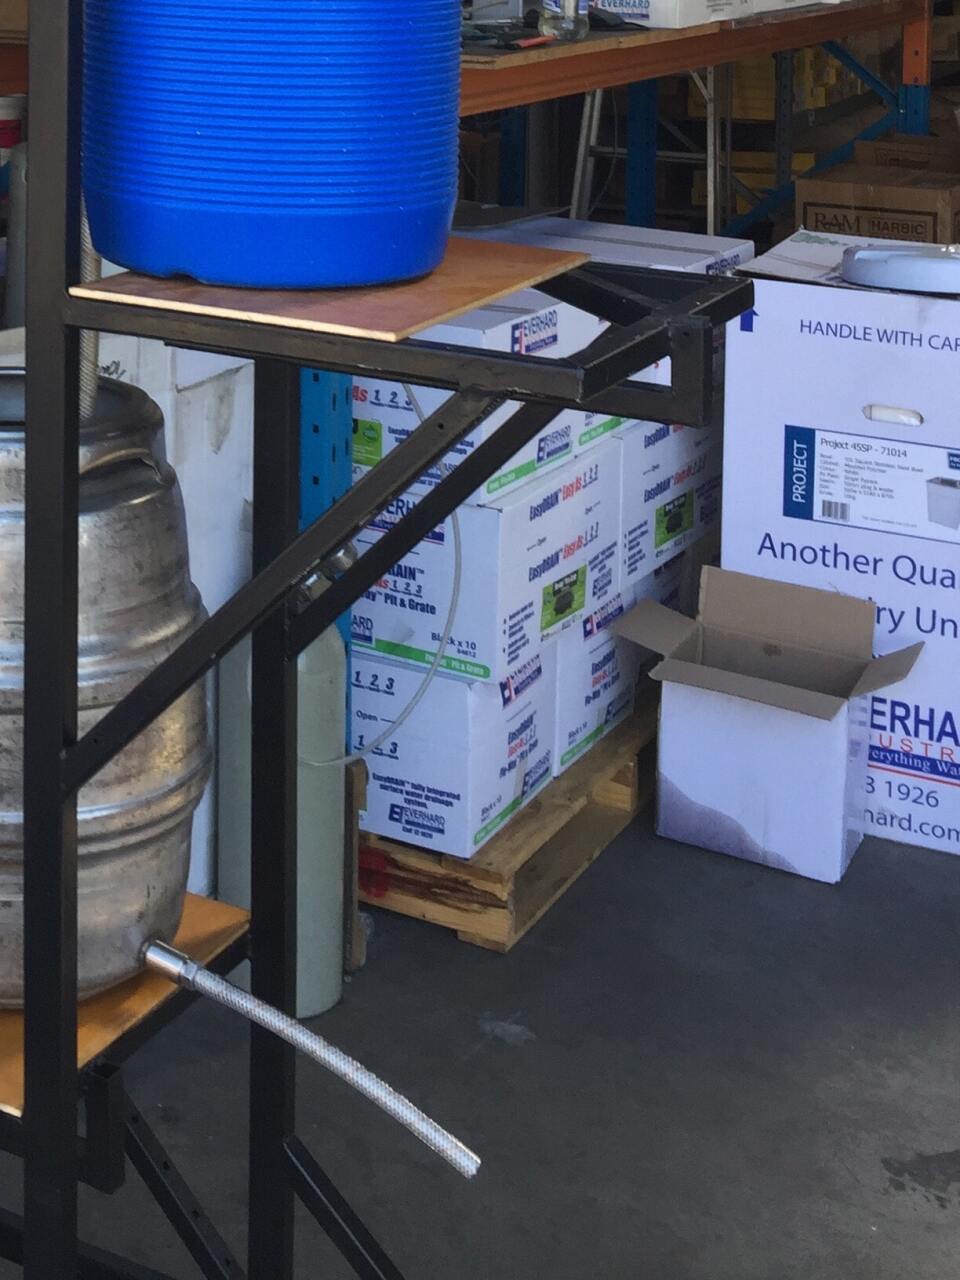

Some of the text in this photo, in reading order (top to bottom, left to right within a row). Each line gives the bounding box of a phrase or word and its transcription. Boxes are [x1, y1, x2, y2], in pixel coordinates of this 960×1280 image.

[601, 0, 650, 9] EVERHARD
[524, 309, 558, 337] EVERHARD
[800, 319, 873, 342] HANDLE
[876, 328, 923, 348] WITH
[820, 437, 849, 451] Project
[851, 443, 873, 454] 45SP
[880, 446, 908, 458] 71014
[792, 440, 808, 503] PROJECT
[757, 532, 956, 589] Another Qua
[384, 593, 398, 607] Pit
[399, 598, 407, 608] &
[408, 599, 437, 615] Grate
[916, 606, 958, 639] Un
[457, 640, 463, 648] x
[465, 640, 477, 651] 10
[354, 670, 395, 690] 1 2 3
[356, 710, 378, 721] Open
[870, 696, 960, 748] ERHA
[357, 734, 399, 754] 1 3
[884, 779, 940, 809] 1926
[404, 806, 446, 825] EVERHARD
